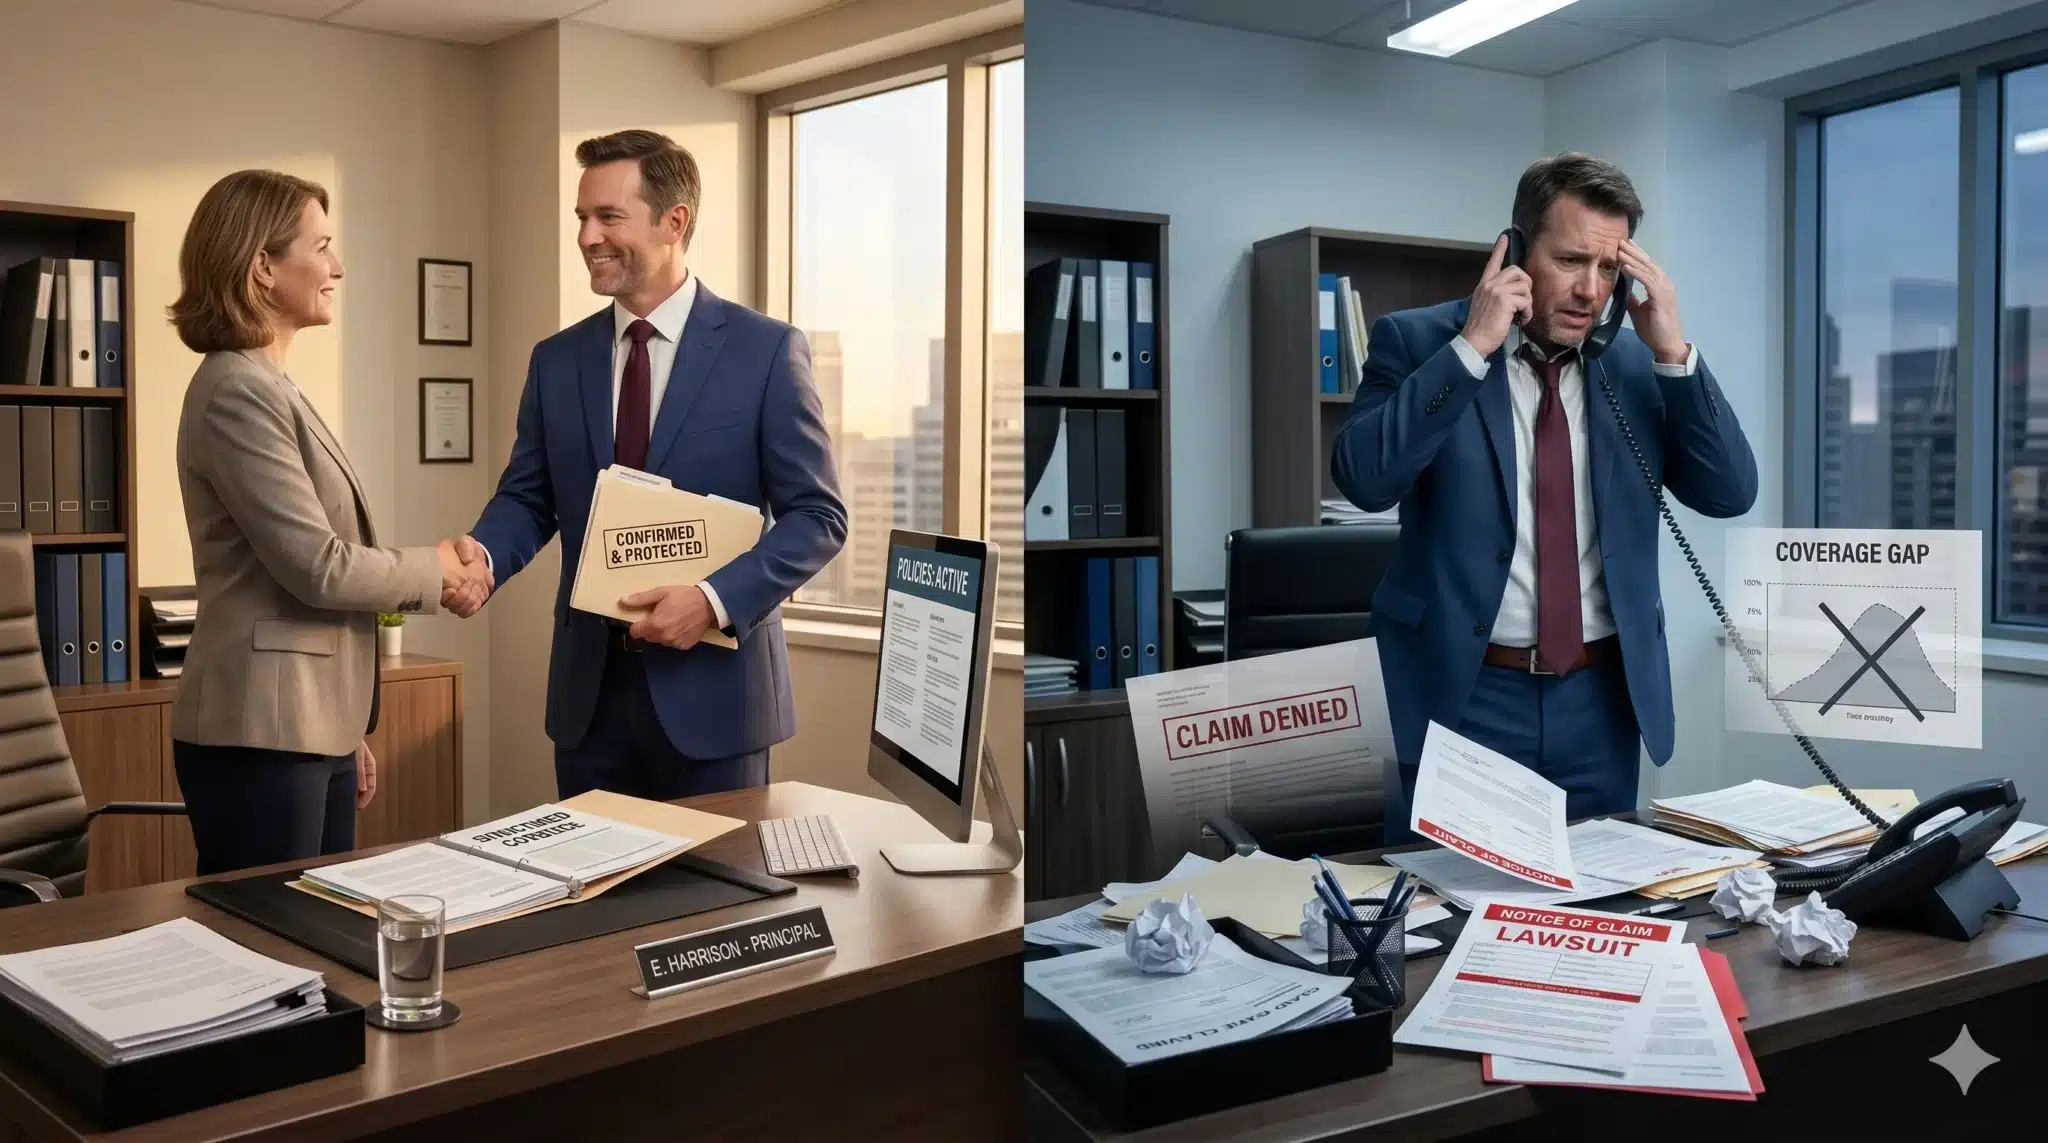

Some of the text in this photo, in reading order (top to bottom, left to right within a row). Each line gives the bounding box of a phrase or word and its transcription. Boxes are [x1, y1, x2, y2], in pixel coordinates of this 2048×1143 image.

[616, 525, 695, 547] CONFIRMED
[611, 541, 702, 564] & PROTECTED
[1776, 541, 1930, 564] COVERAGE GAP
[935, 566, 968, 595] ACTIVE
[1747, 607, 1762, 615] 75%
[1176, 697, 1348, 749] CLAIM DENIED
[1480, 851, 1499, 864] OF
[1500, 909, 1653, 937] NOTICE OF CLAIM
[650, 959, 667, 977] E.
[668, 940, 742, 973] HARRISON
[750, 922, 821, 953] PRINCIPAL
[1496, 926, 1640, 957] LAWSUIT
